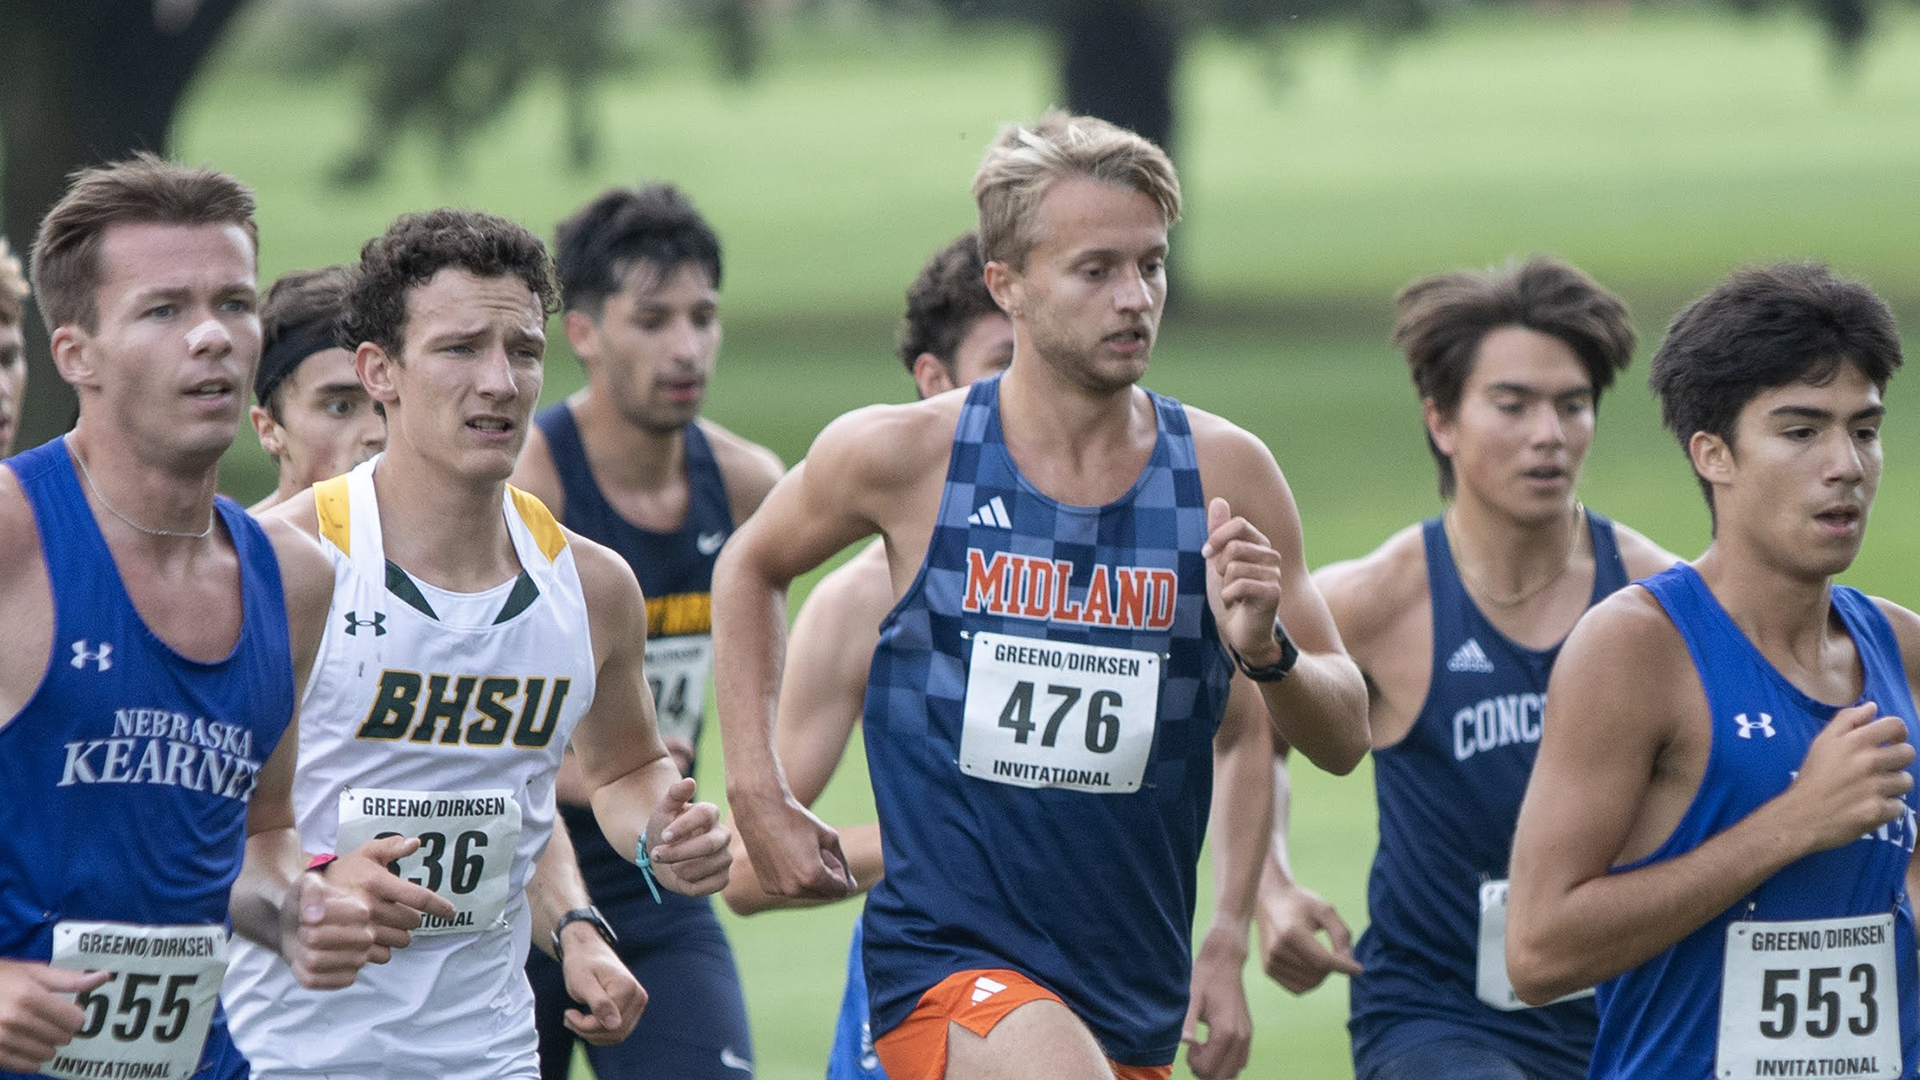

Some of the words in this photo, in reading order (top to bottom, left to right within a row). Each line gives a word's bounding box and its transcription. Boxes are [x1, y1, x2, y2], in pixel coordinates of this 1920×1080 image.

[962, 547, 1178, 631] MIDLAND
[995, 644, 1140, 677] GREENO/DIRKSEN
[355, 668, 572, 749] BHSU
[998, 681, 1123, 754] 476
[110, 707, 253, 759] NEBRASKA
[993, 760, 1111, 786] INVITATIONAL
[362, 797, 506, 819] GREENO/DIRKSEN
[79, 932, 214, 958] GREENO/DIRKSEN
[1752, 925, 1886, 952] GREENO/DIRKSEN
[1760, 963, 1879, 1040] 553
[52, 1056, 170, 1079] INVITATIONAL
[1755, 1056, 1880, 1077] INVITATIONAL
